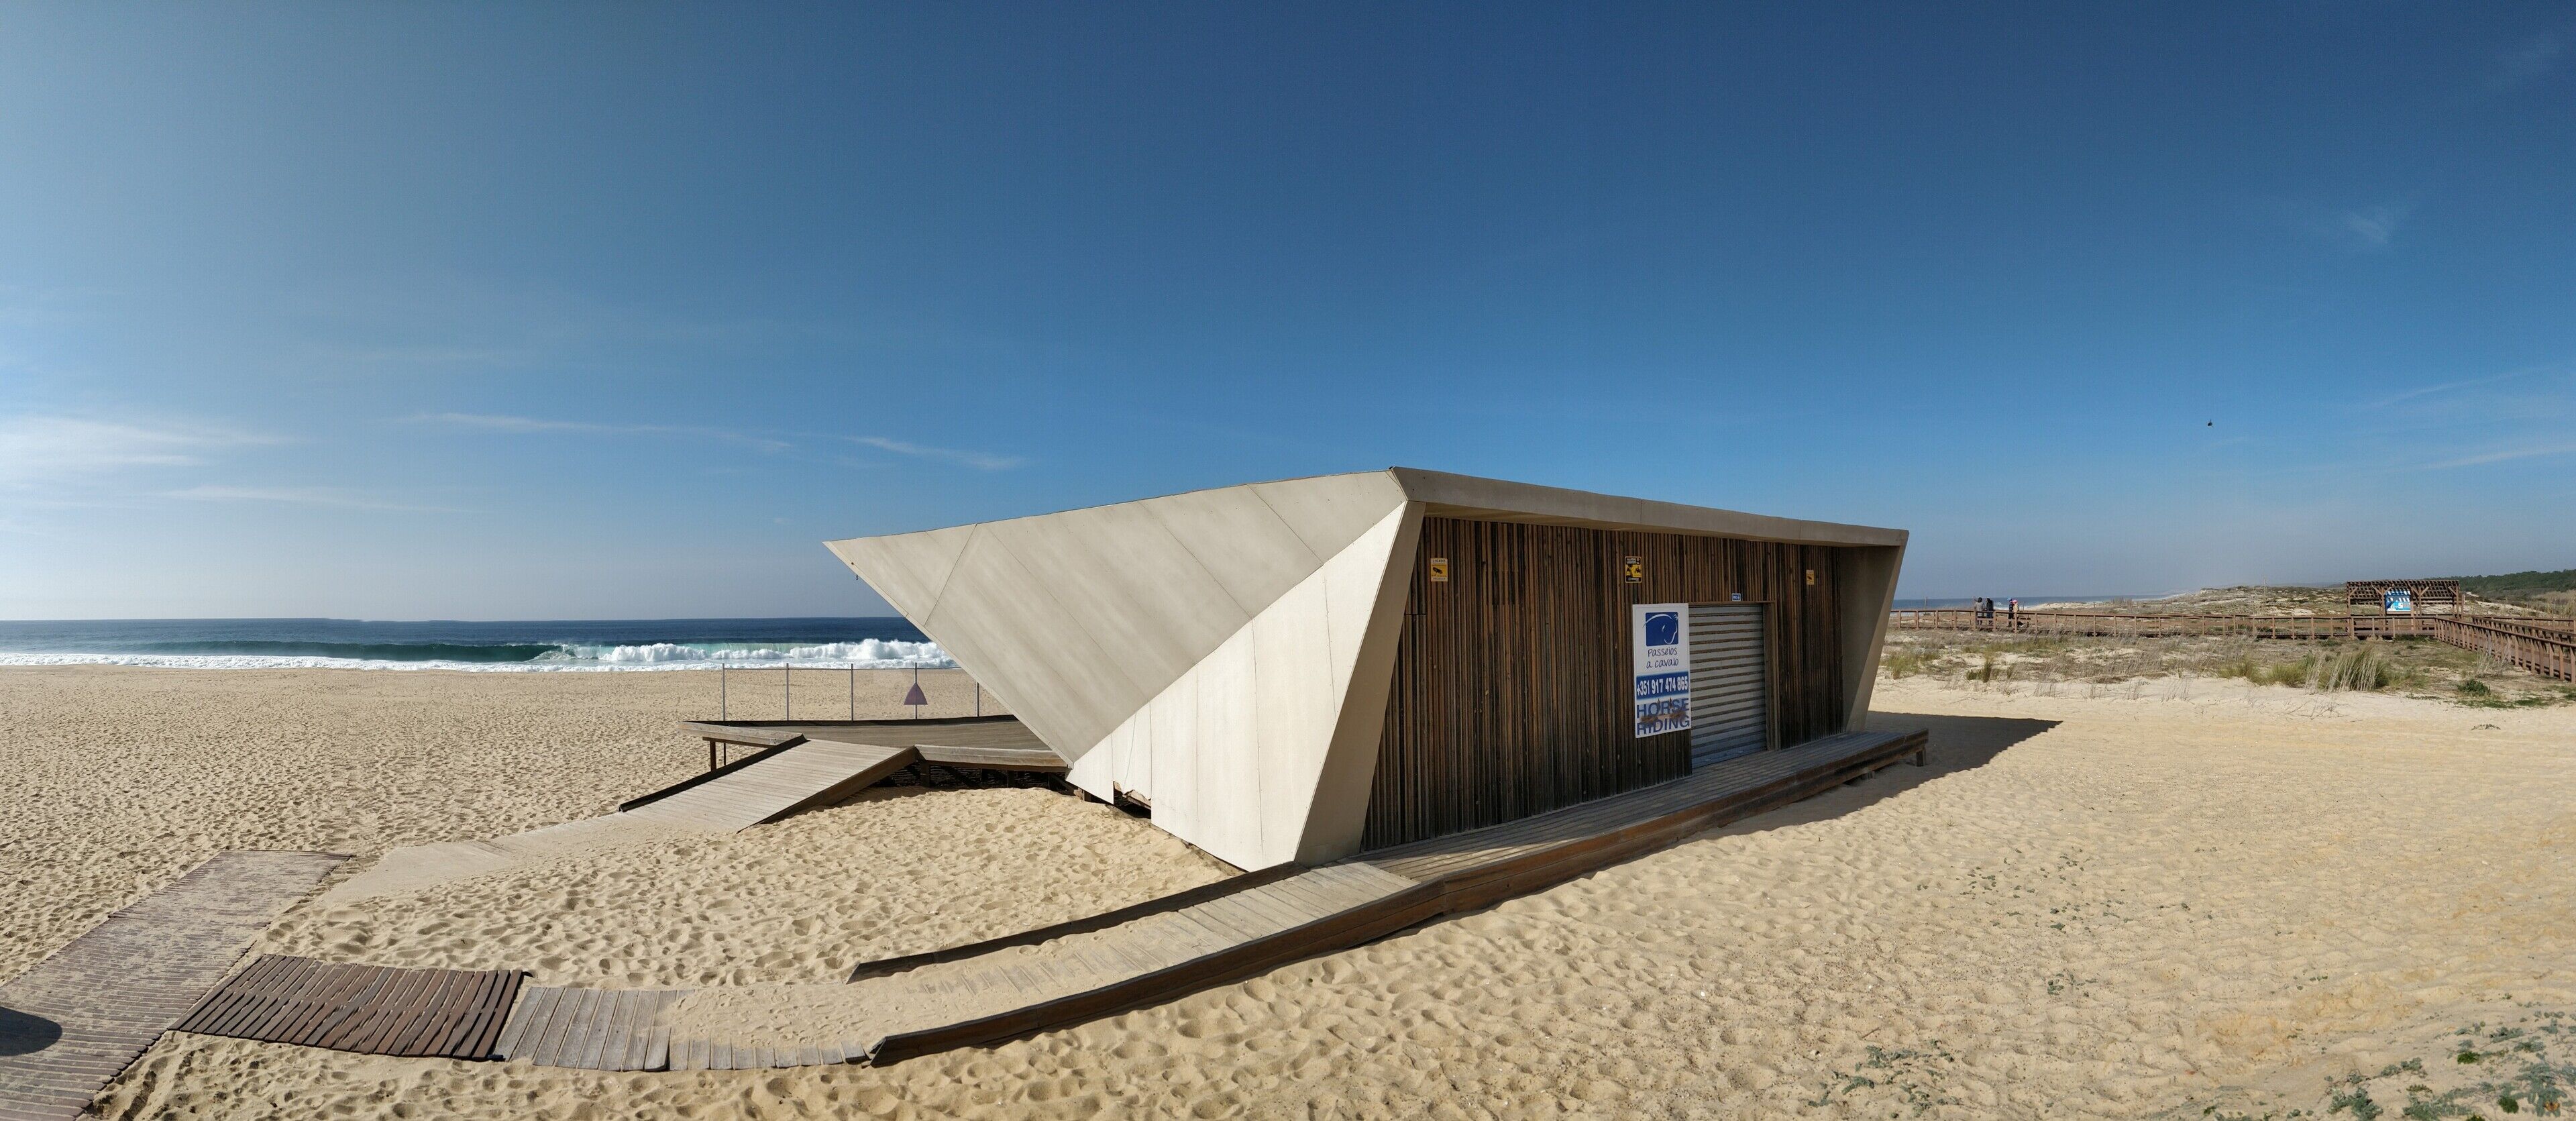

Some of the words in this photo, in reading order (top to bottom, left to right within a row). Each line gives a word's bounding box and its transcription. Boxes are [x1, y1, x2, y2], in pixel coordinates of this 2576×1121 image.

[1648, 647, 1678, 657] Passeios
[1646, 661, 1652, 669] a
[1654, 658, 1679, 668] cavalo
[1637, 680, 1650, 696] +351
[1651, 678, 1664, 694] 917
[1665, 677, 1676, 692] 474
[1677, 676, 1688, 691] 865
[1637, 698, 1689, 718] HORSE
[1637, 714, 1690, 735] RIDING
